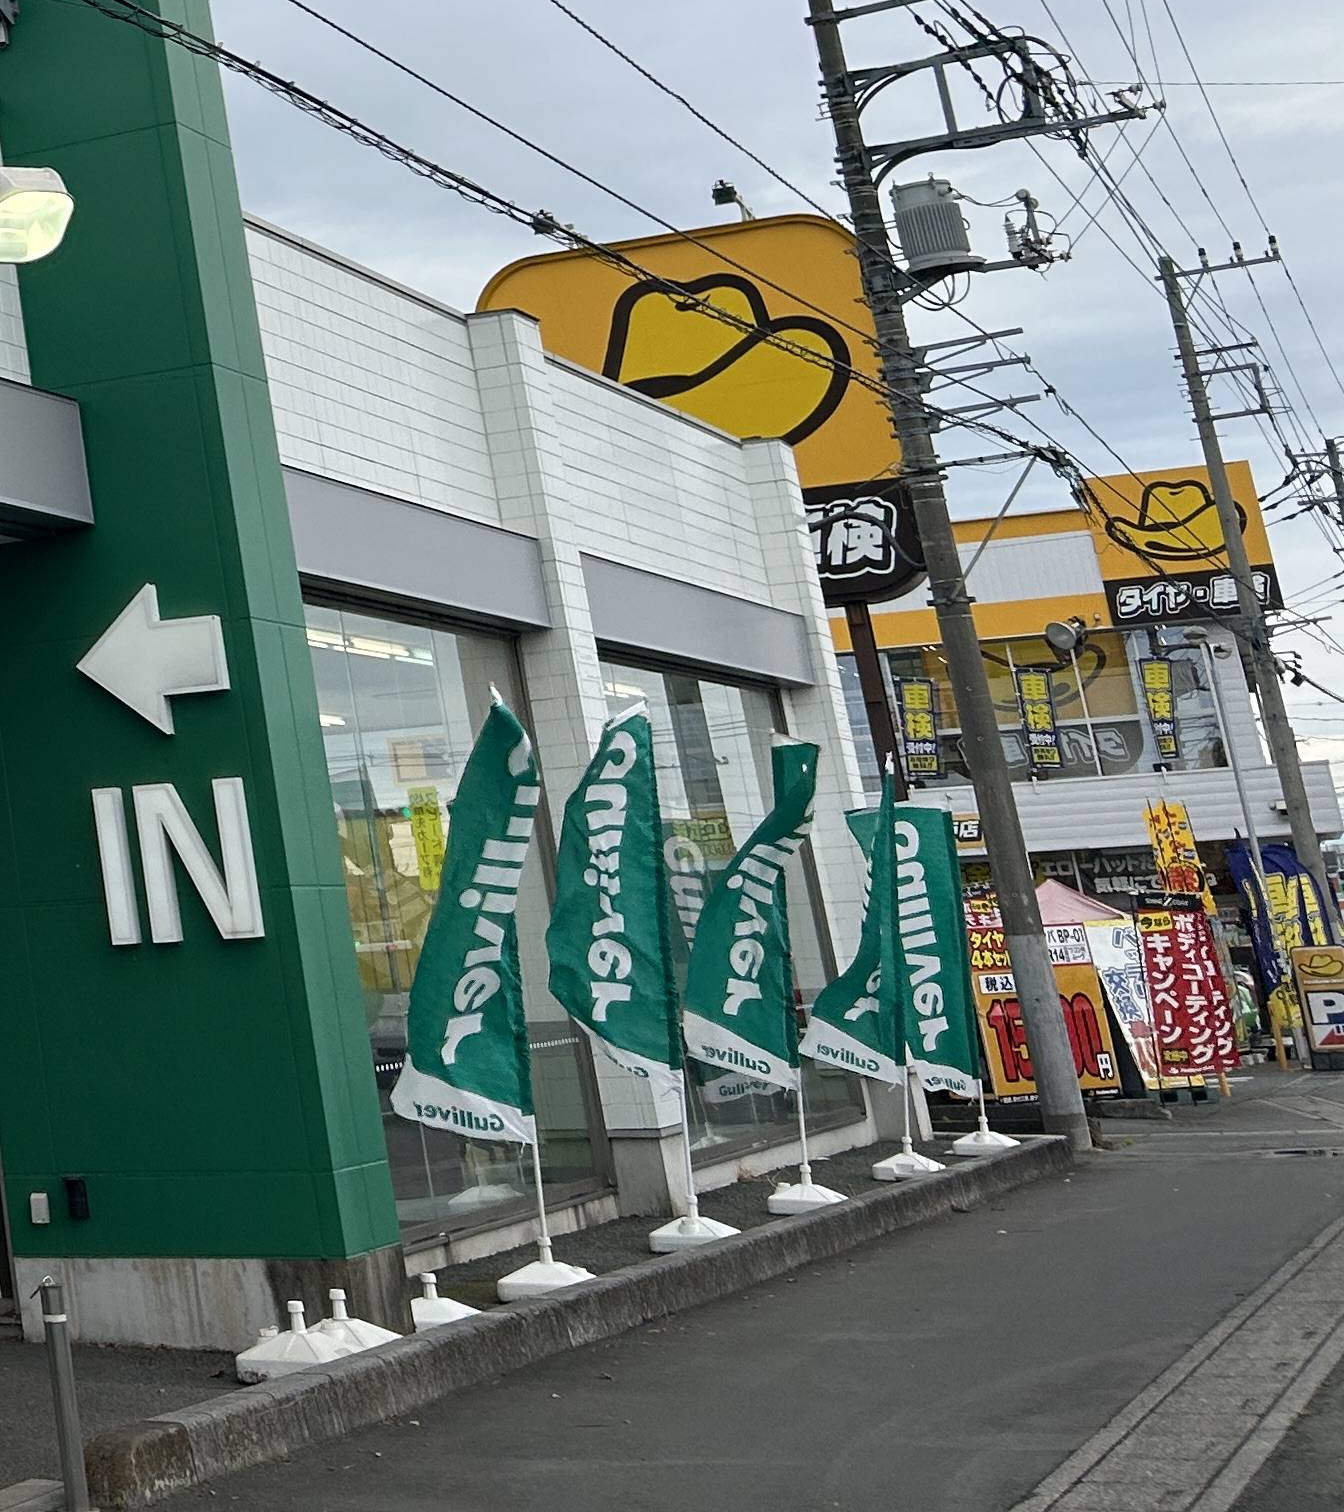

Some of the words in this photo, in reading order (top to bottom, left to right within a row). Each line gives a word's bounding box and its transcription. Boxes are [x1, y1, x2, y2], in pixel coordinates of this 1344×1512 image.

[903, 683, 934, 738] 車検
[1019, 673, 1053, 730] 車検
[1143, 662, 1172, 719] 車検
[90, 776, 265, 946] IN
[970, 930, 1005, 948] タイヤ
[984, 976, 1014, 992] 税込
[1146, 934, 1182, 1045] キャンペーン
